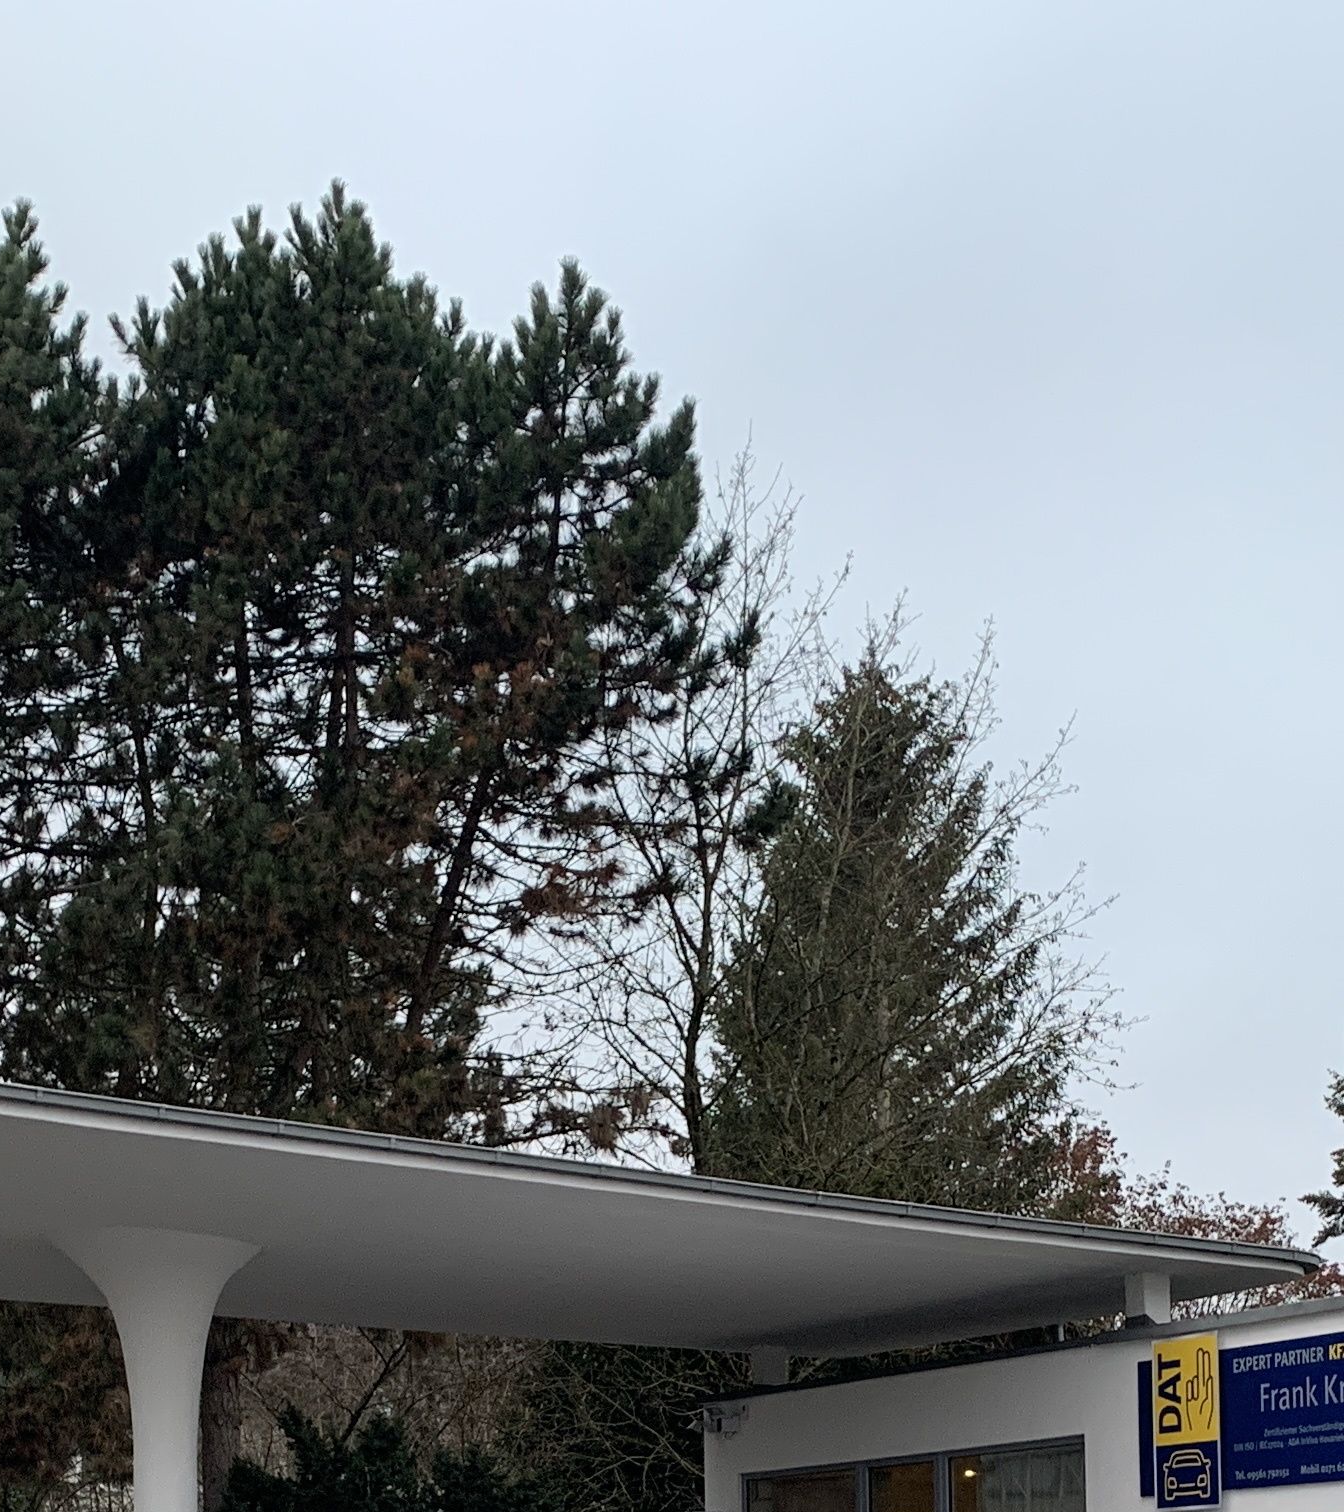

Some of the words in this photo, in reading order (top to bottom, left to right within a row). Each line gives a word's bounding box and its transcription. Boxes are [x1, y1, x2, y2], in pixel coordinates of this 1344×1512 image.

[1232, 1353, 1273, 1374] EXPERT
[1274, 1346, 1325, 1368] PARTNER
[1157, 1352, 1182, 1435] DAT
[1259, 1375, 1319, 1413] Frank
